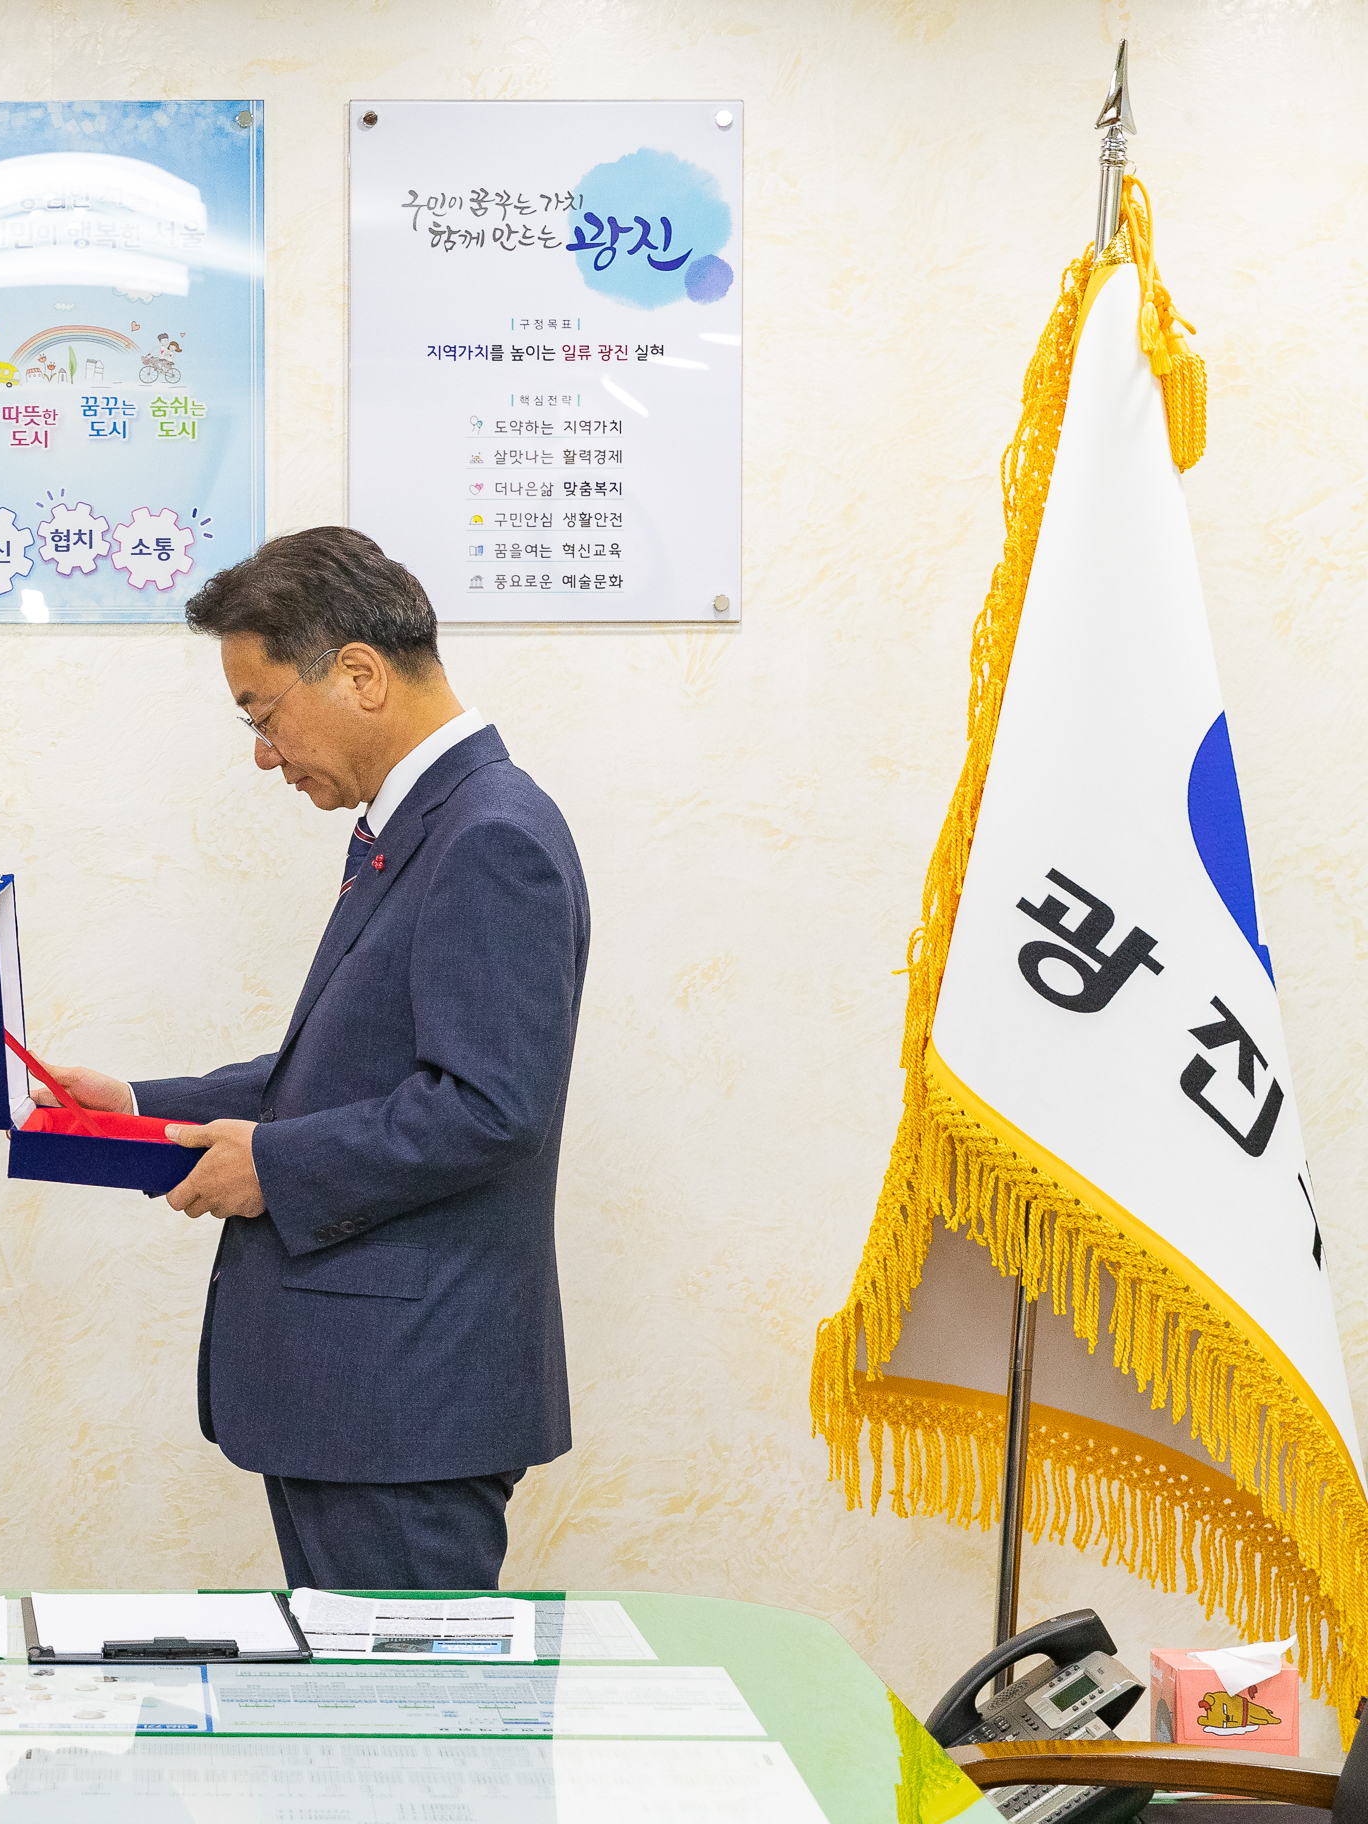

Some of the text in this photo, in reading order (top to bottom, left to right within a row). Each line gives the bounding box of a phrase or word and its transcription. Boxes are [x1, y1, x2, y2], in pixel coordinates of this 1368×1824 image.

[401, 187, 584, 231] 구민이 꿈꾸는 가치
[428, 211, 693, 272] 함께 만드는 광진
[427, 344, 504, 362] 지역가치를
[510, 344, 556, 362] 높이는
[561, 344, 592, 361] 일류
[597, 344, 628, 361] 광진
[2, 405, 59, 426] 따뜻한
[80, 396, 137, 417] 꿈꾸는
[149, 396, 206, 417] 숨쉬는
[88, 421, 128, 439] 도시
[157, 421, 197, 439] 도시
[494, 420, 623, 435] 도약하는 지역가치
[10, 431, 49, 449] 도시
[494, 449, 623, 465] 살맛나는 활력경제
[494, 481, 623, 497] 더나은삶 맞춤복지
[494, 512, 623, 528] 구민안심 생활안전
[50, 528, 93, 552] 협치
[131, 537, 175, 561] 소통
[494, 543, 622, 559] 꿈을여는 혁신교육
[494, 574, 623, 590] 풍요로운 예술문화
